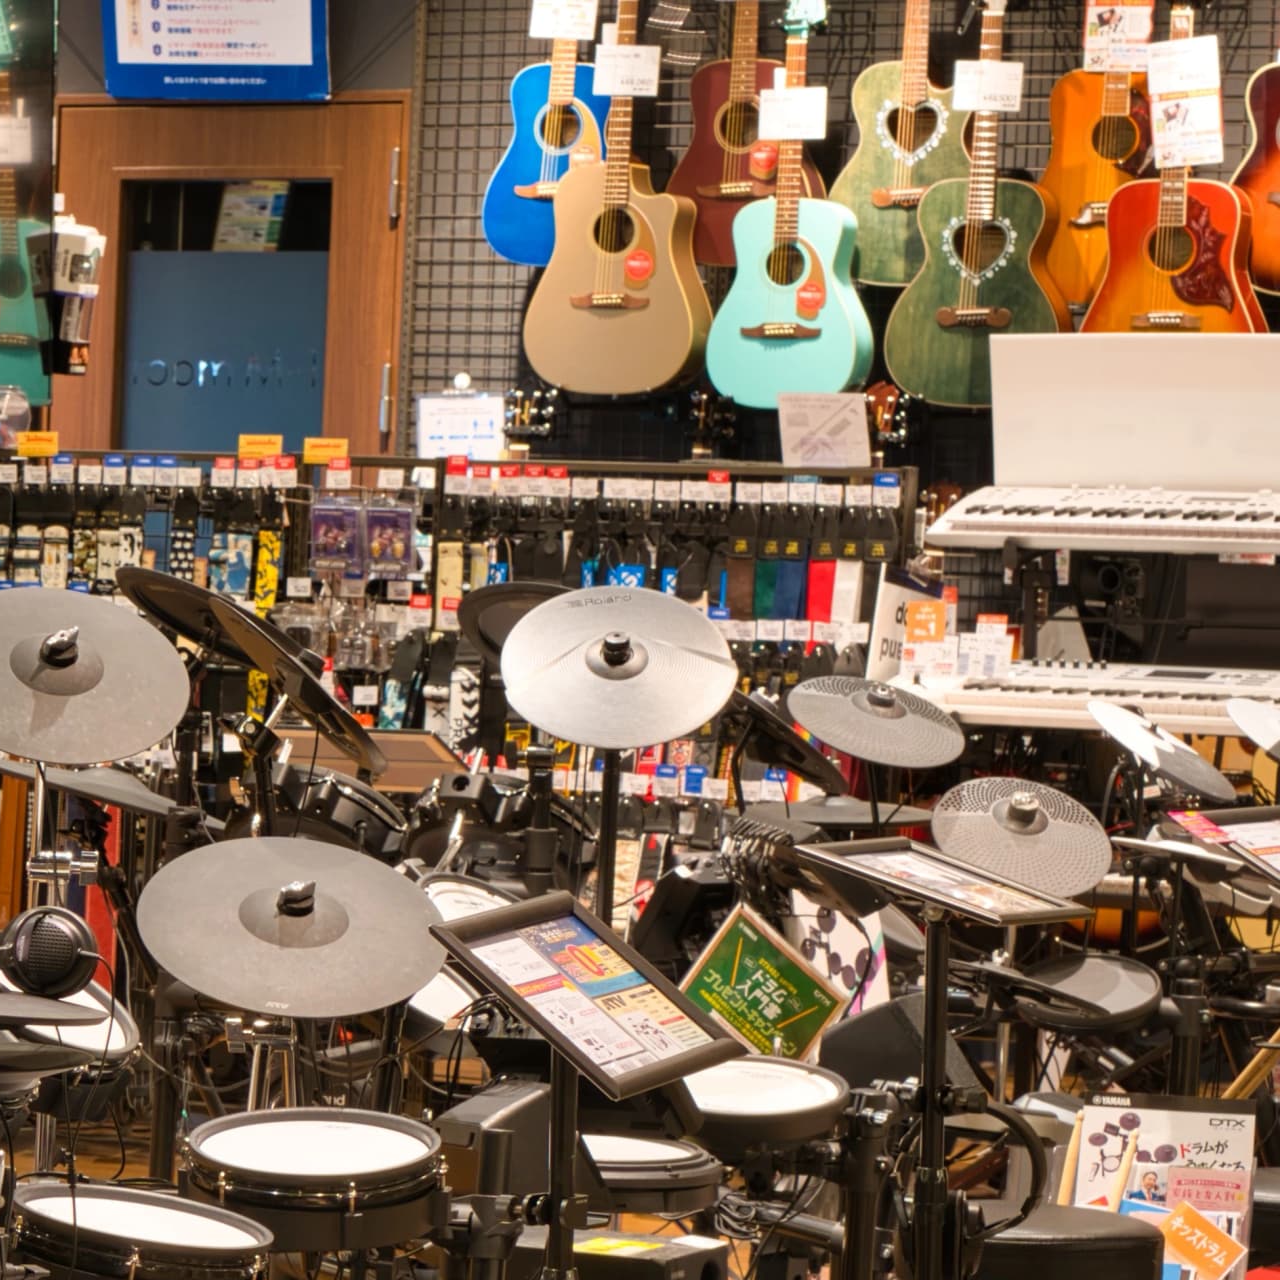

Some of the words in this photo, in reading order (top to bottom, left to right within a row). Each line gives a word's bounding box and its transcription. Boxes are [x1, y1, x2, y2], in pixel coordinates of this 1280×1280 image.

[584, 592, 632, 608] Roland
[751, 968, 788, 1004] ドラム
[736, 977, 782, 1021] 入門書
[1102, 1095, 1131, 1108] YAMAHA
[1209, 1117, 1246, 1129] DTX
[1179, 1141, 1230, 1160] ドラムが
[1169, 1213, 1230, 1269] キッズドラム
